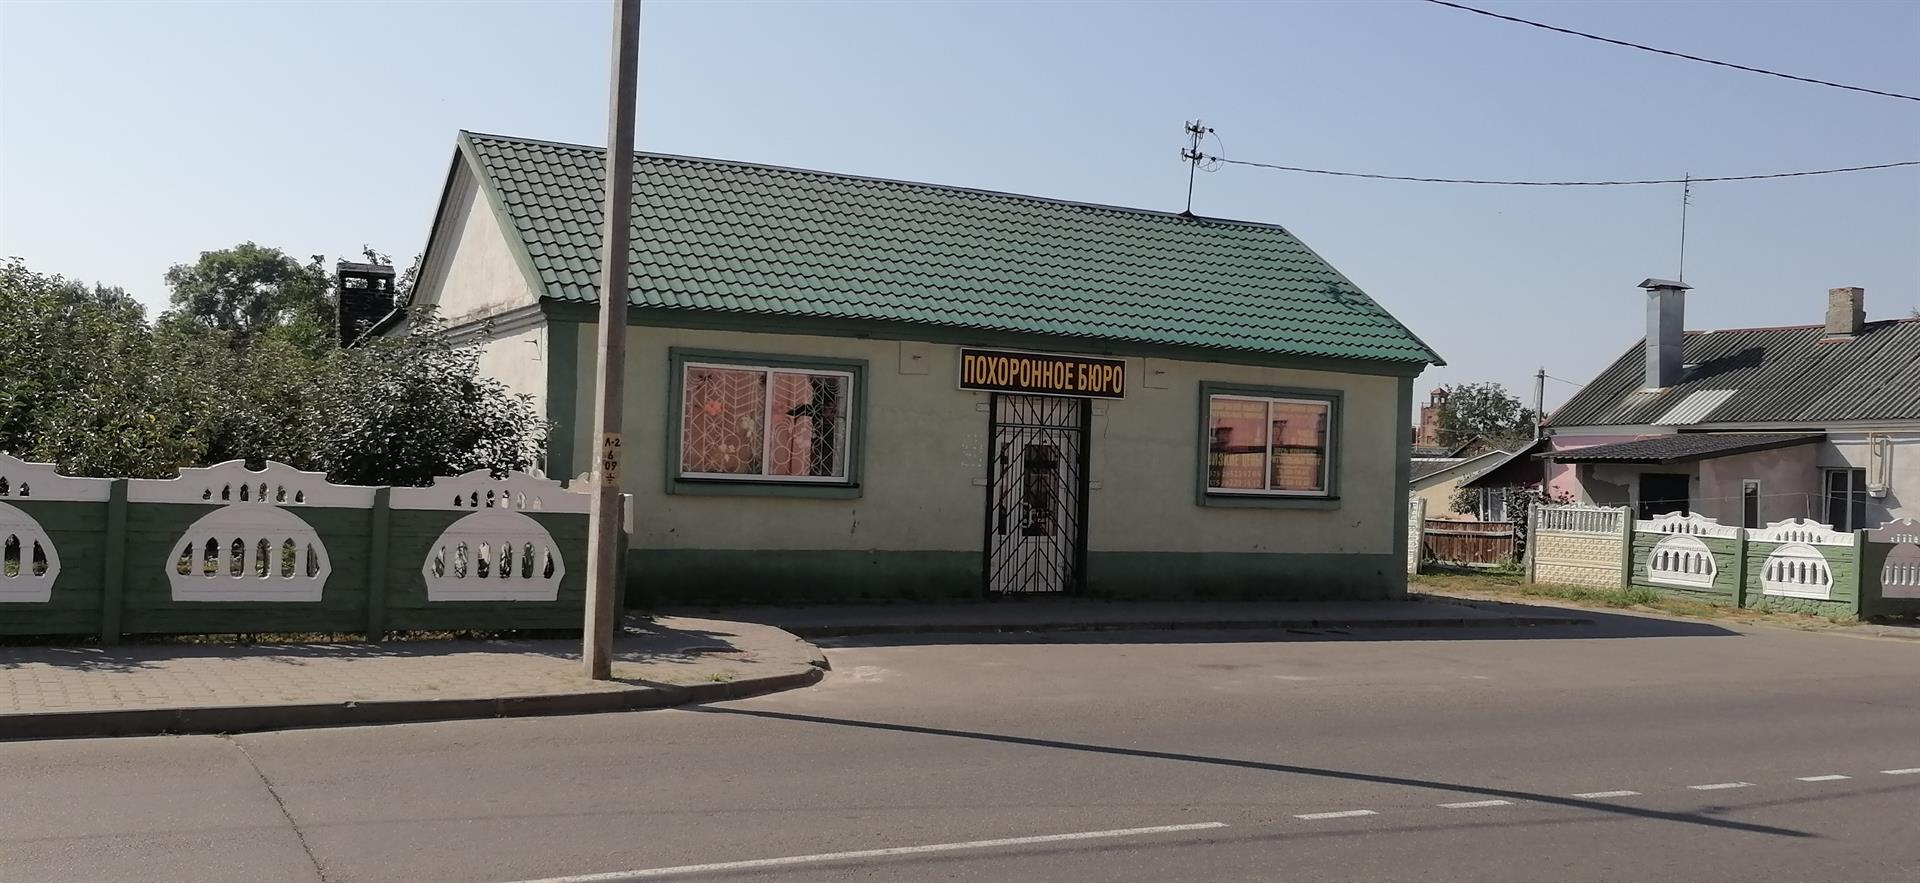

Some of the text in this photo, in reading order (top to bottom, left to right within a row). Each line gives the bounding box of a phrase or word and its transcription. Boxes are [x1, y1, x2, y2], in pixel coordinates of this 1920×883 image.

[964, 355, 1123, 394] ПОХОРОННОЕ БЮРО
[607, 450, 614, 460] 6
[604, 461, 617, 470] 09
